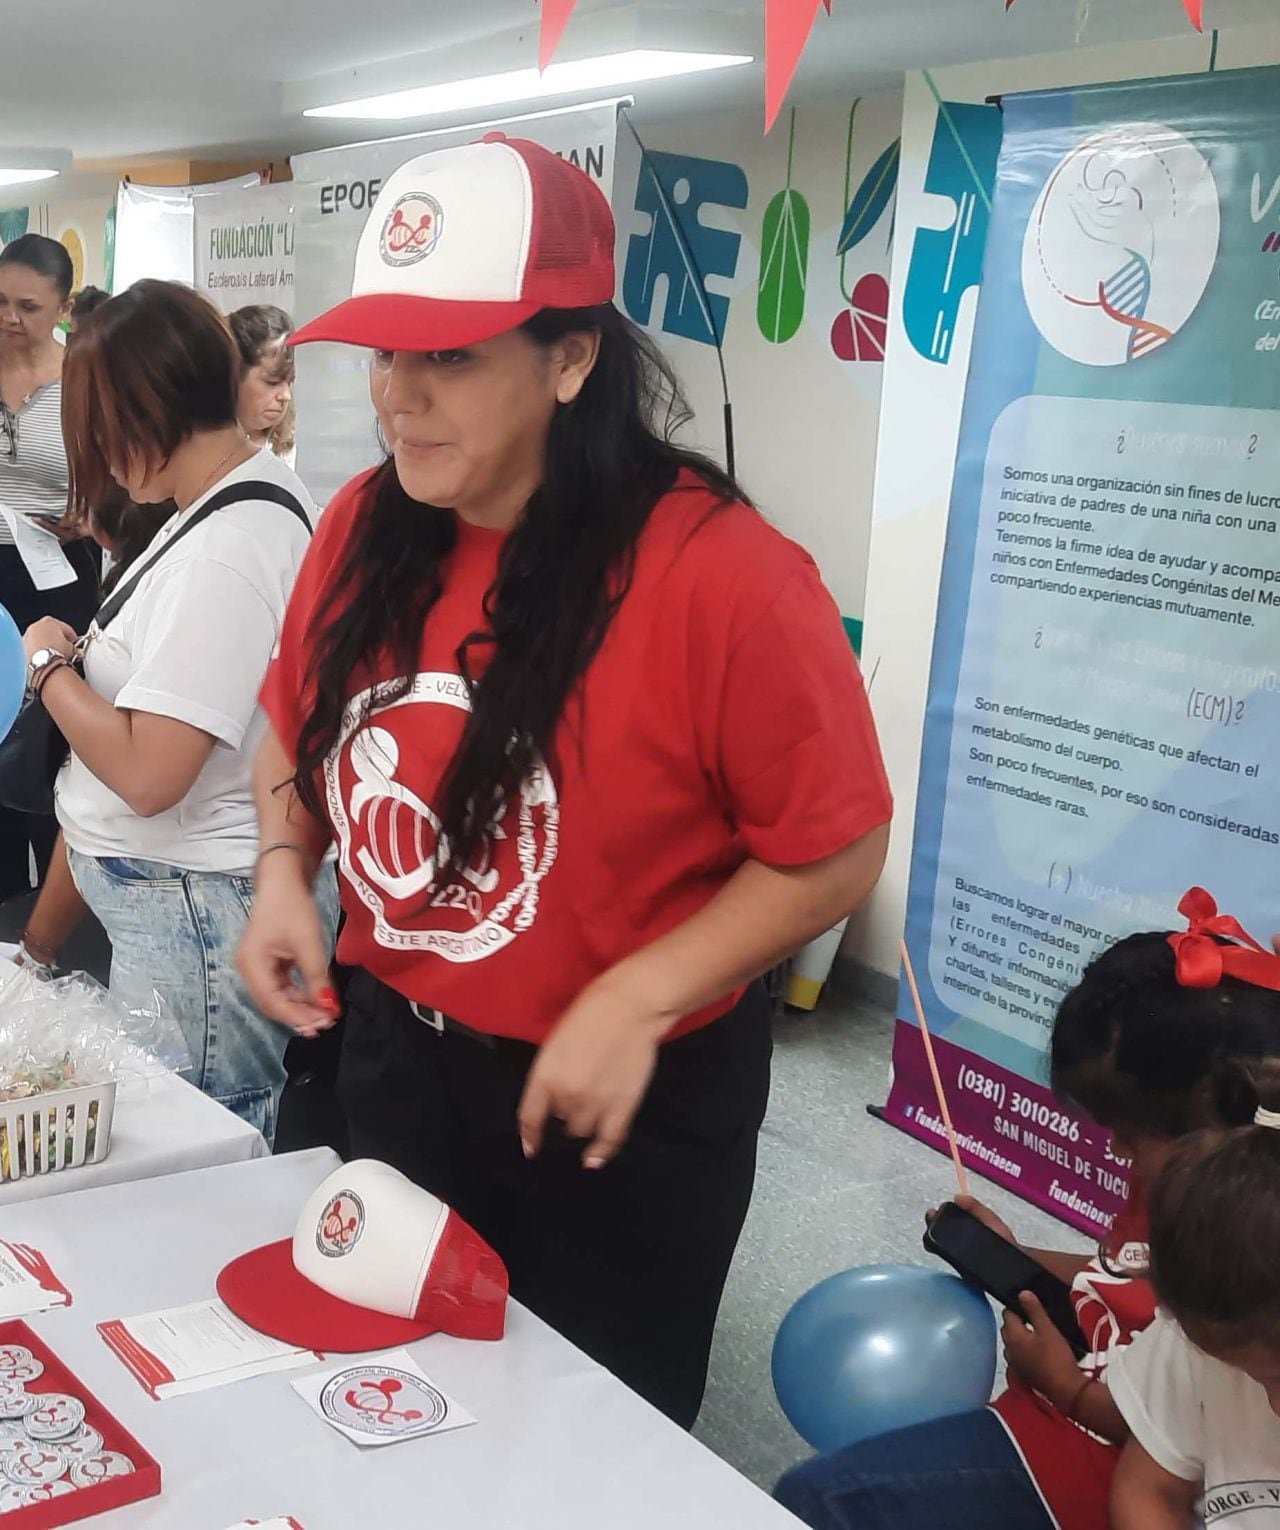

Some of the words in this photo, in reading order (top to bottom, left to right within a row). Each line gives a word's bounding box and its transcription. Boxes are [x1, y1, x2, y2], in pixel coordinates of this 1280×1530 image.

[210, 217, 273, 260] FUNDACIÓN
[208, 270, 247, 289] Esclerosis
[248, 269, 277, 288] Lateral
[1003, 466, 1049, 484] Somos
[1051, 474, 1074, 486] una
[1076, 475, 1162, 496] organización
[1164, 484, 1185, 499] sin
[1188, 485, 1221, 502] fines
[1224, 489, 1243, 504] de
[997, 511, 1031, 525] poco
[1032, 512, 1095, 533] frecuente.
[1000, 487, 1057, 506] iniciativa
[1060, 494, 1077, 508] de
[1080, 496, 1126, 516] padres
[1130, 501, 1147, 516] de
[1152, 507, 1177, 520] una
[1182, 508, 1211, 525] niña
[1215, 514, 1242, 529] con
[1247, 519, 1277, 533] una
[996, 529, 1052, 549] Tenemos
[1056, 536, 1067, 551] la
[1070, 538, 1103, 556] firme
[1106, 543, 1134, 561] idea
[1138, 549, 1155, 564] de
[1159, 553, 1207, 573] ayudar
[1210, 561, 1218, 575] y
[990, 572, 1077, 596] compartiendo
[1078, 587, 1163, 611] experiencias
[1165, 600, 1256, 627] mutuamente.
[992, 551, 1027, 567] niños
[1029, 556, 1053, 570] con
[1055, 559, 1149, 587] Enfermedades
[1152, 573, 1228, 600] Congénitas
[1231, 585, 1255, 602] del
[1257, 589, 1280, 607] Me
[972, 723, 1052, 752] metabolismo
[1055, 742, 1074, 758] del
[1075, 749, 1124, 773] cuerpo.
[974, 696, 1000, 714] Son
[1003, 702, 1091, 736] enfermedades
[1093, 725, 1155, 752] genéticas
[1158, 743, 1184, 760] que
[1186, 748, 1241, 777] afectan
[1245, 763, 1260, 778] el
[966, 773, 1052, 808] enfermedades
[1054, 798, 1089, 819] raras.
[969, 746, 994, 766] Son
[996, 756, 1028, 774] poco
[1031, 762, 1098, 794] frecuentes,
[1101, 784, 1124, 800] por
[1125, 790, 1149, 808] eso
[1151, 798, 1176, 816] son
[1178, 807, 1280, 845] consideradas
[950, 915, 1008, 948] (Errores
[952, 896, 970, 913] las
[991, 913, 1080, 954] enfermedades
[955, 877, 1015, 909] Buscamos
[1016, 898, 1050, 919] lograr
[1051, 914, 1062, 926] el
[1063, 918, 1102, 941] mayor
[948, 934, 958, 947] Y
[961, 941, 1003, 966] difundir
[943, 973, 982, 998] interior
[982, 990, 997, 1005] de
[998, 995, 1008, 1010] la
[945, 955, 989, 983] charlas,
[991, 973, 1032, 1000] talleres
[1033, 991, 1042, 1006] y
[957, 1063, 1007, 1109] (0381)
[1009, 1092, 1081, 1143] 3010286
[993, 1115, 1020, 1142] SAN
[1022, 1130, 1071, 1169] MIGUEL
[1074, 1155, 1092, 1180] DE
